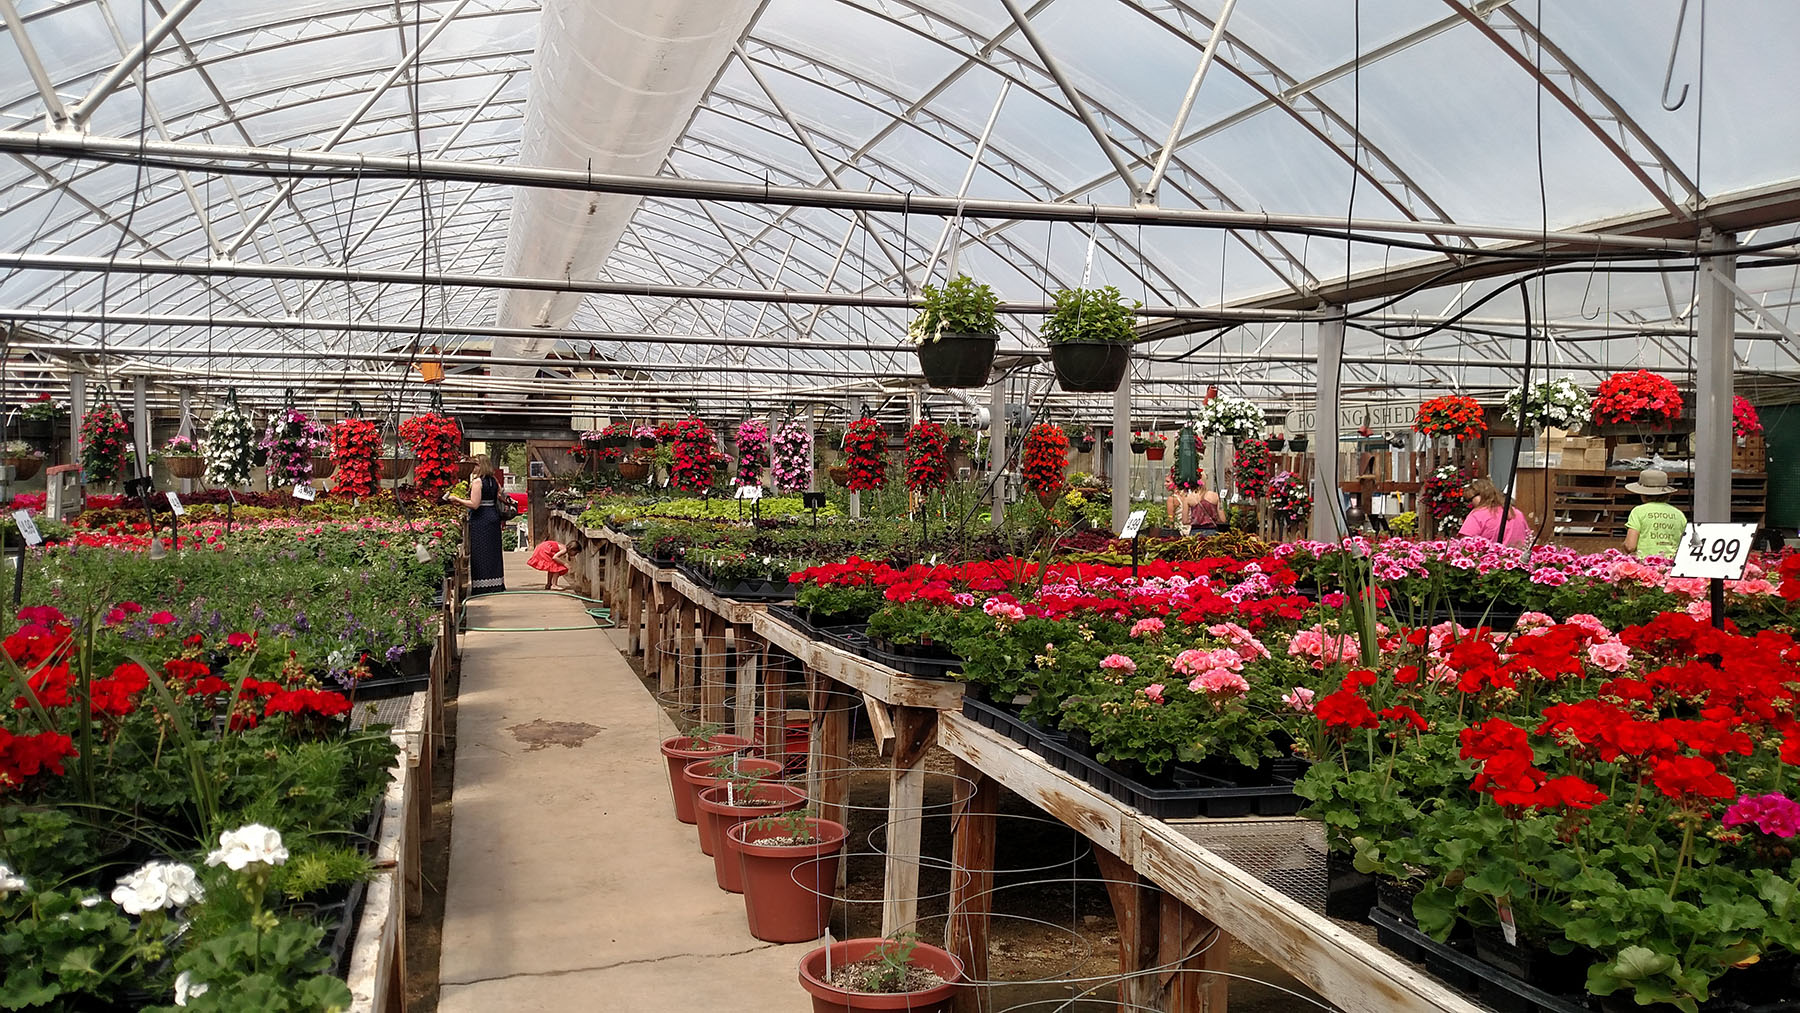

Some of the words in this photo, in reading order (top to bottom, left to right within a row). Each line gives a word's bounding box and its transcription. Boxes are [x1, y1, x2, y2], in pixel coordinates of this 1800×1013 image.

[1298, 410, 1362, 429] PONG
[1373, 406, 1416, 425] SHED
[1689, 538, 1741, 563] 4.99
